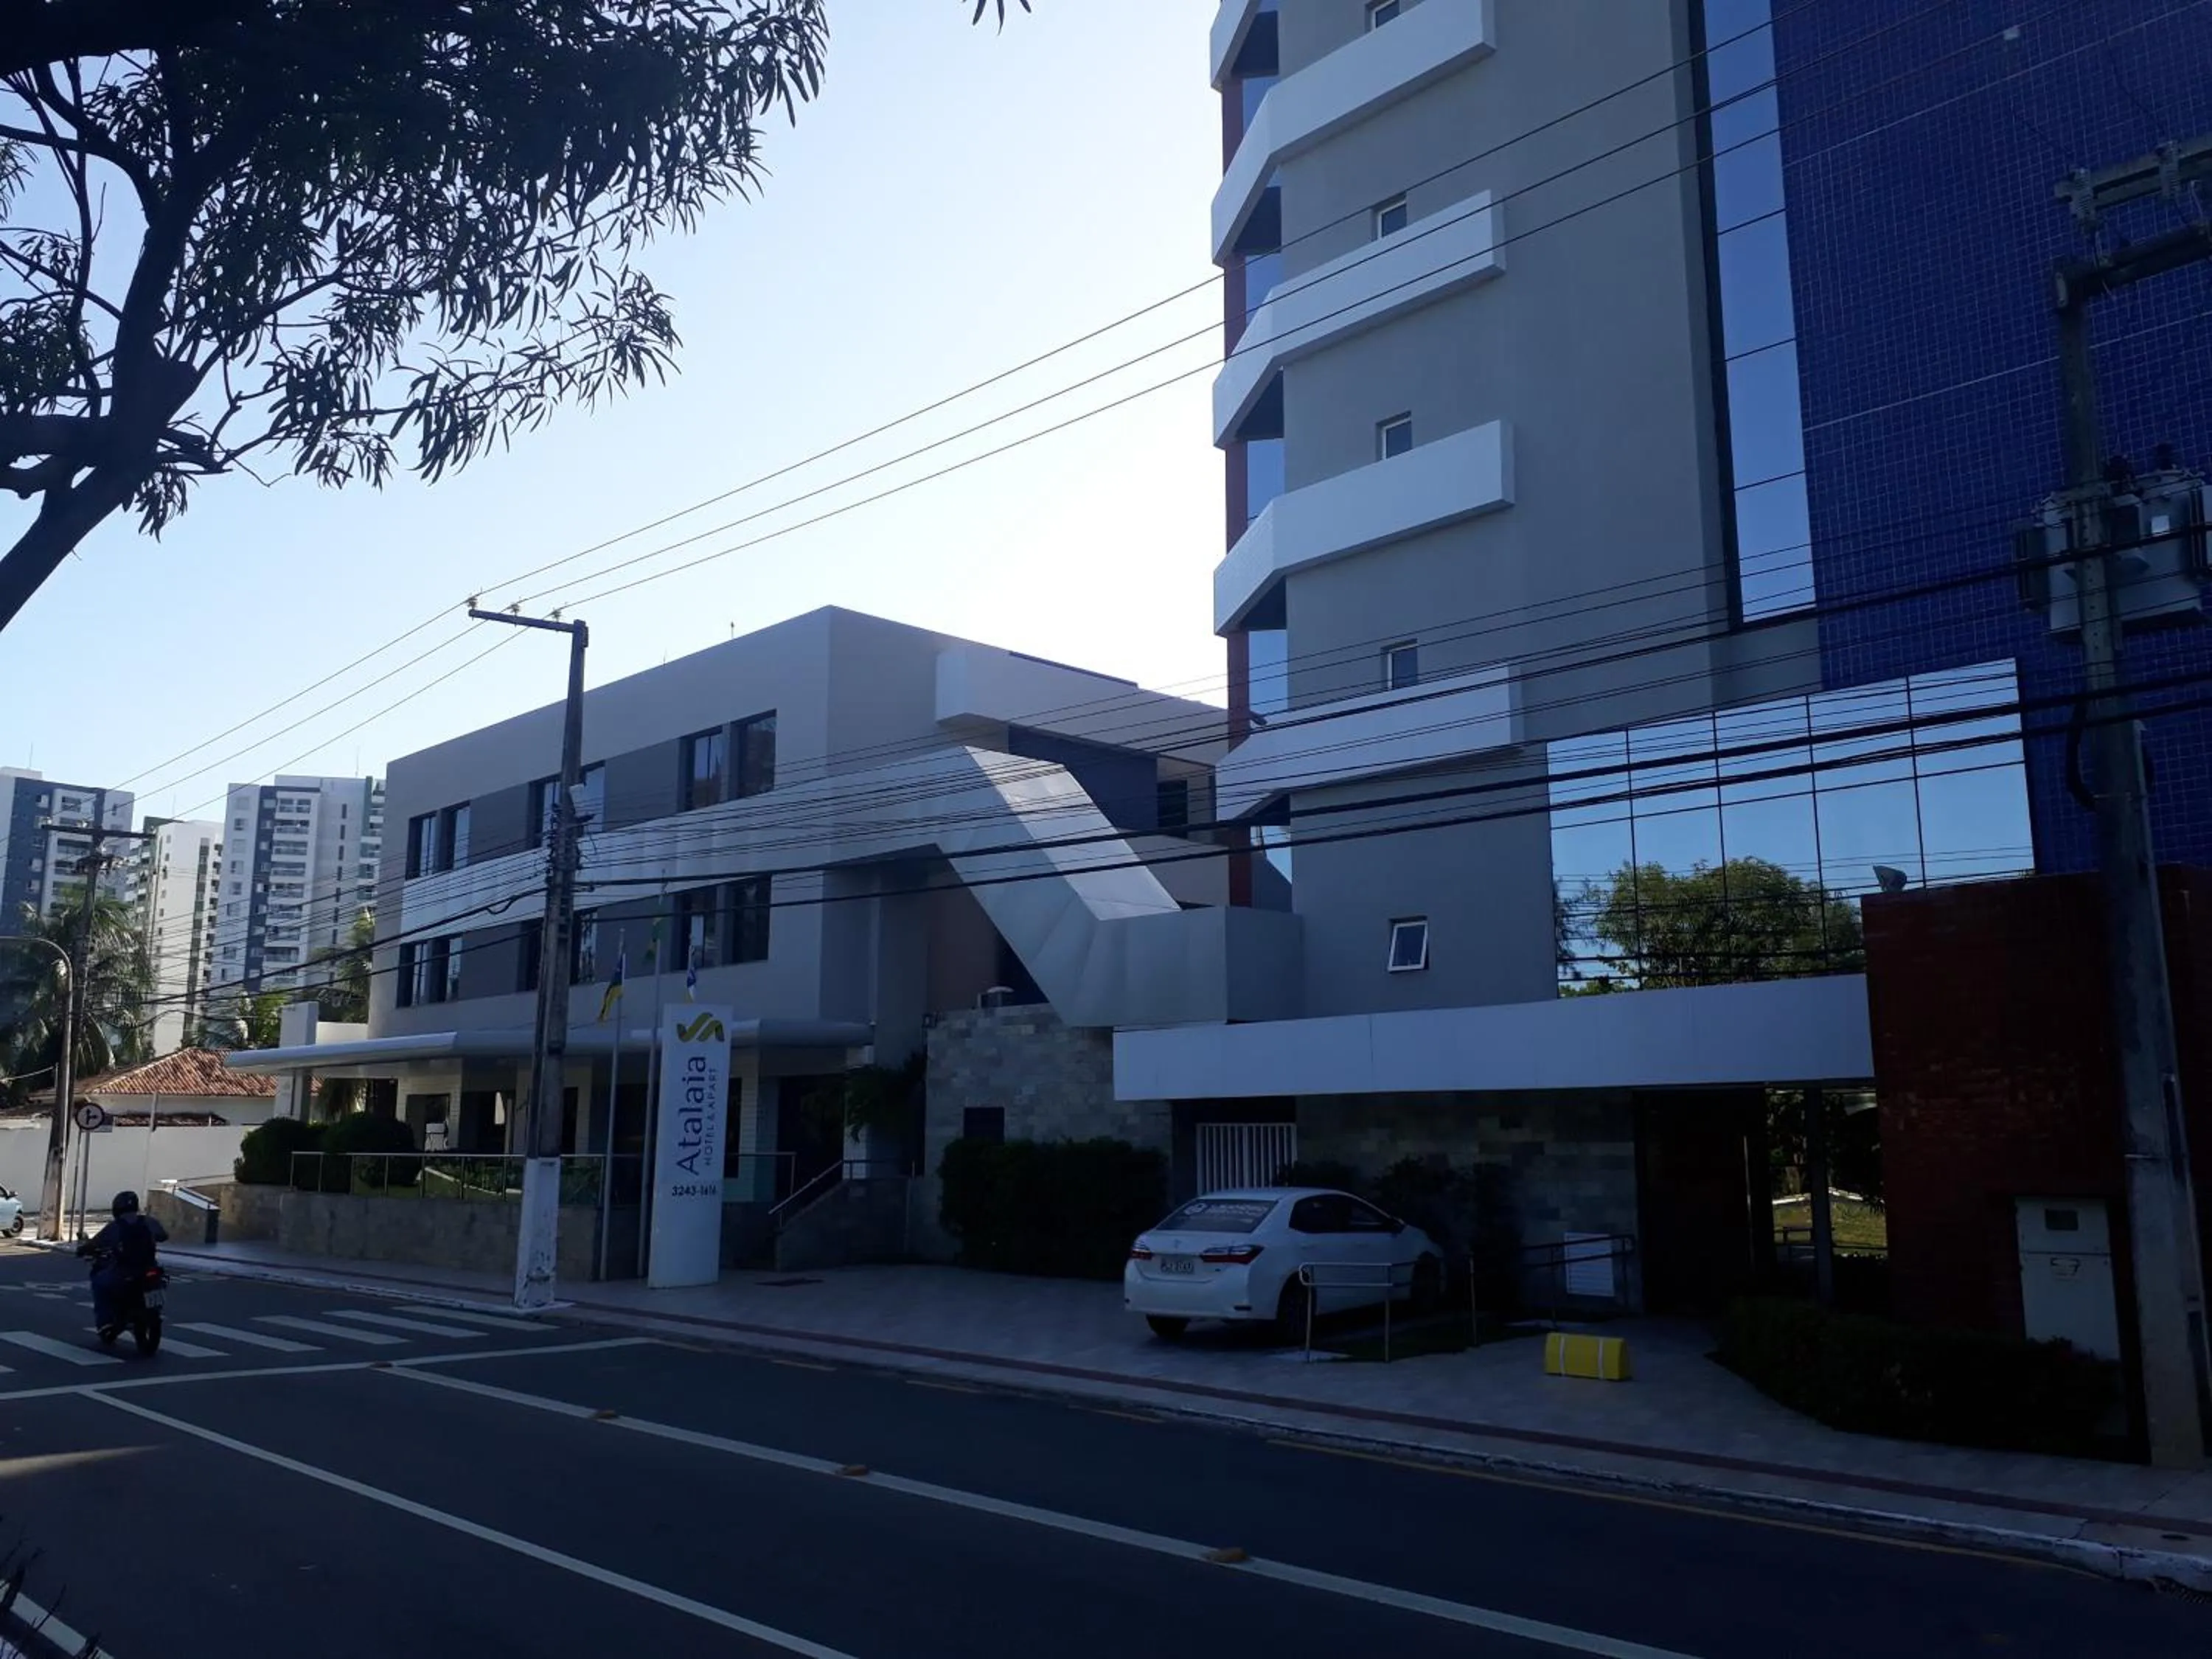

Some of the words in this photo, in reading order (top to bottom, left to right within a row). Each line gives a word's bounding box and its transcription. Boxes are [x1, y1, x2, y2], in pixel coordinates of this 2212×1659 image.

[708, 1068, 718, 1110] APART
[675, 1056, 706, 1176] Atalaia
[705, 1124, 714, 1166] HOTEL
